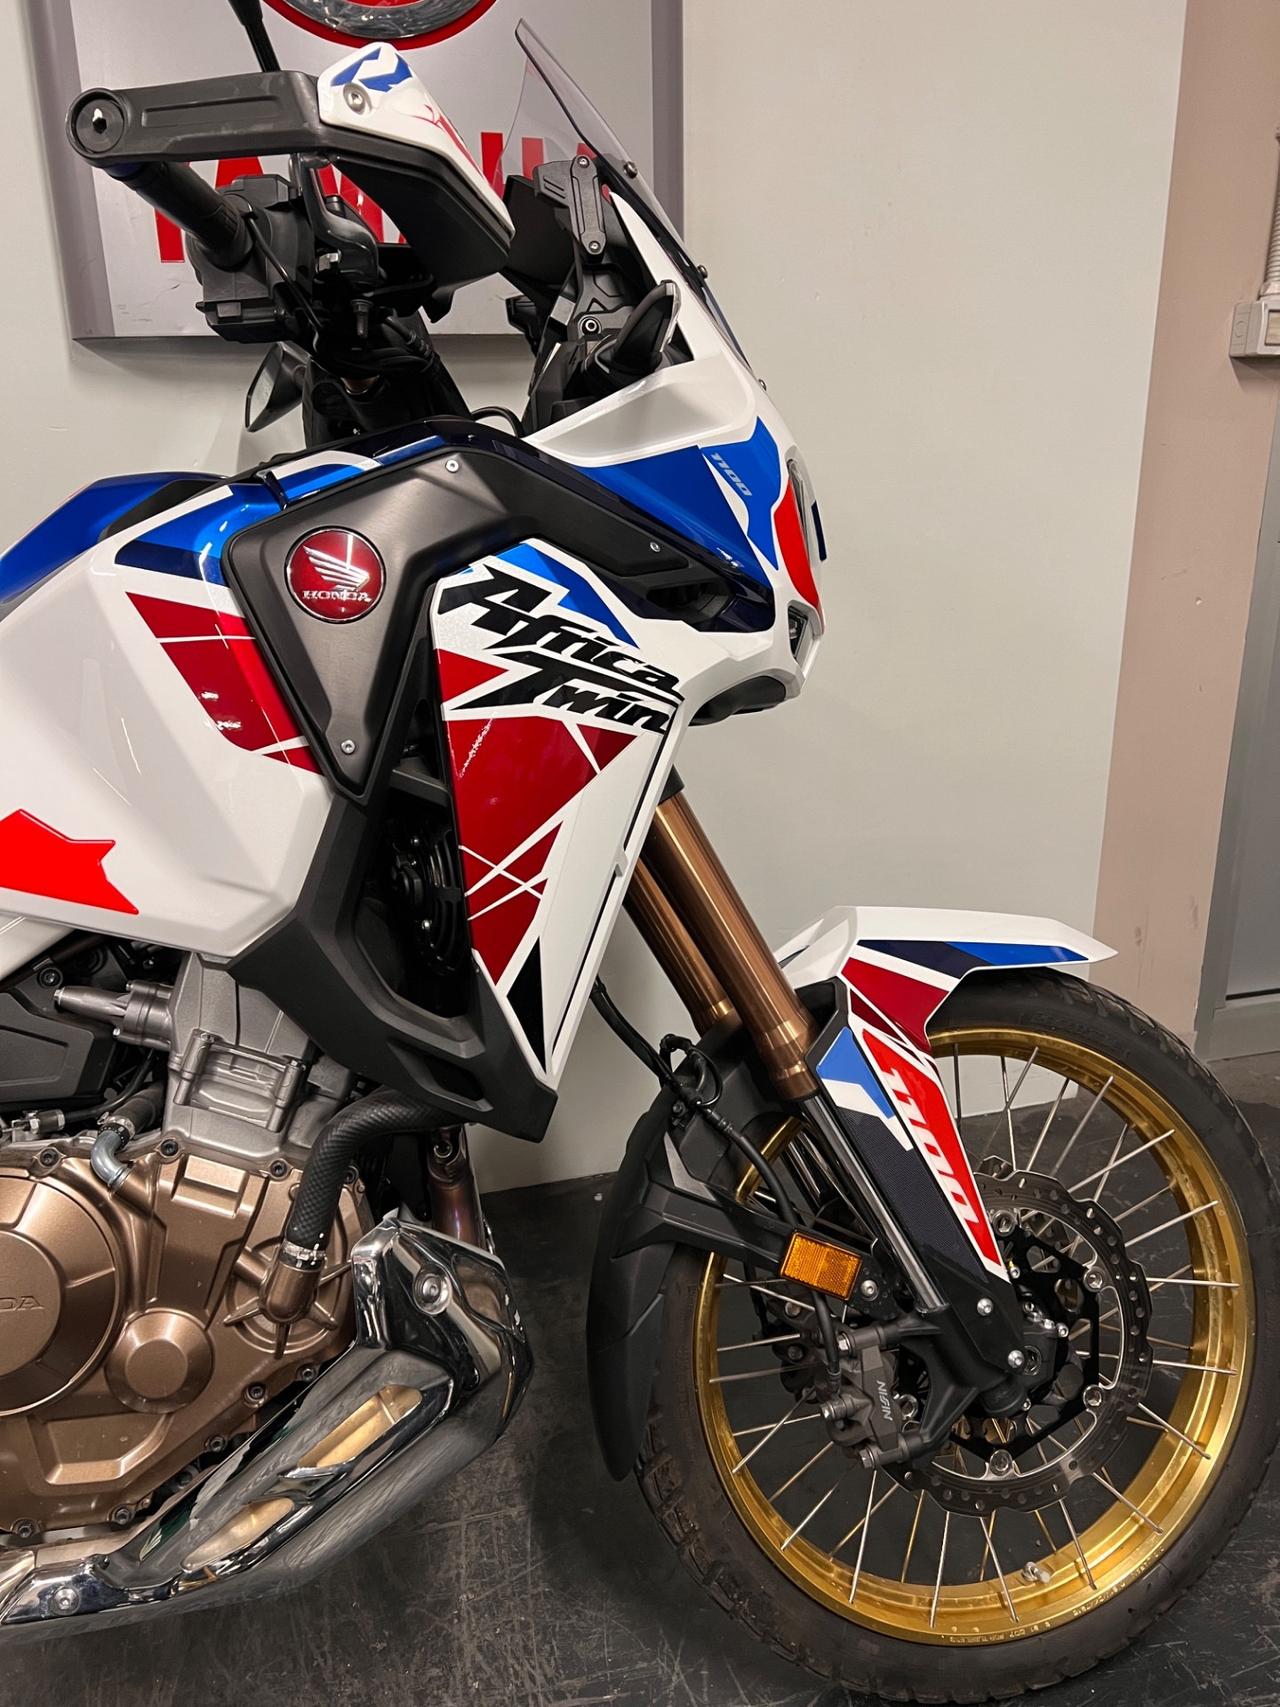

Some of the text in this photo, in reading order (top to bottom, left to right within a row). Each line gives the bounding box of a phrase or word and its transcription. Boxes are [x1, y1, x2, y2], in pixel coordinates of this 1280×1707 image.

[710, 452, 753, 497] 1100
[302, 588, 372, 603] HONDA
[437, 563, 681, 693] Africa
[450, 651, 686, 734] Twin
[882, 1067, 979, 1225] 1100
[876, 1380, 894, 1421] NISSIN
